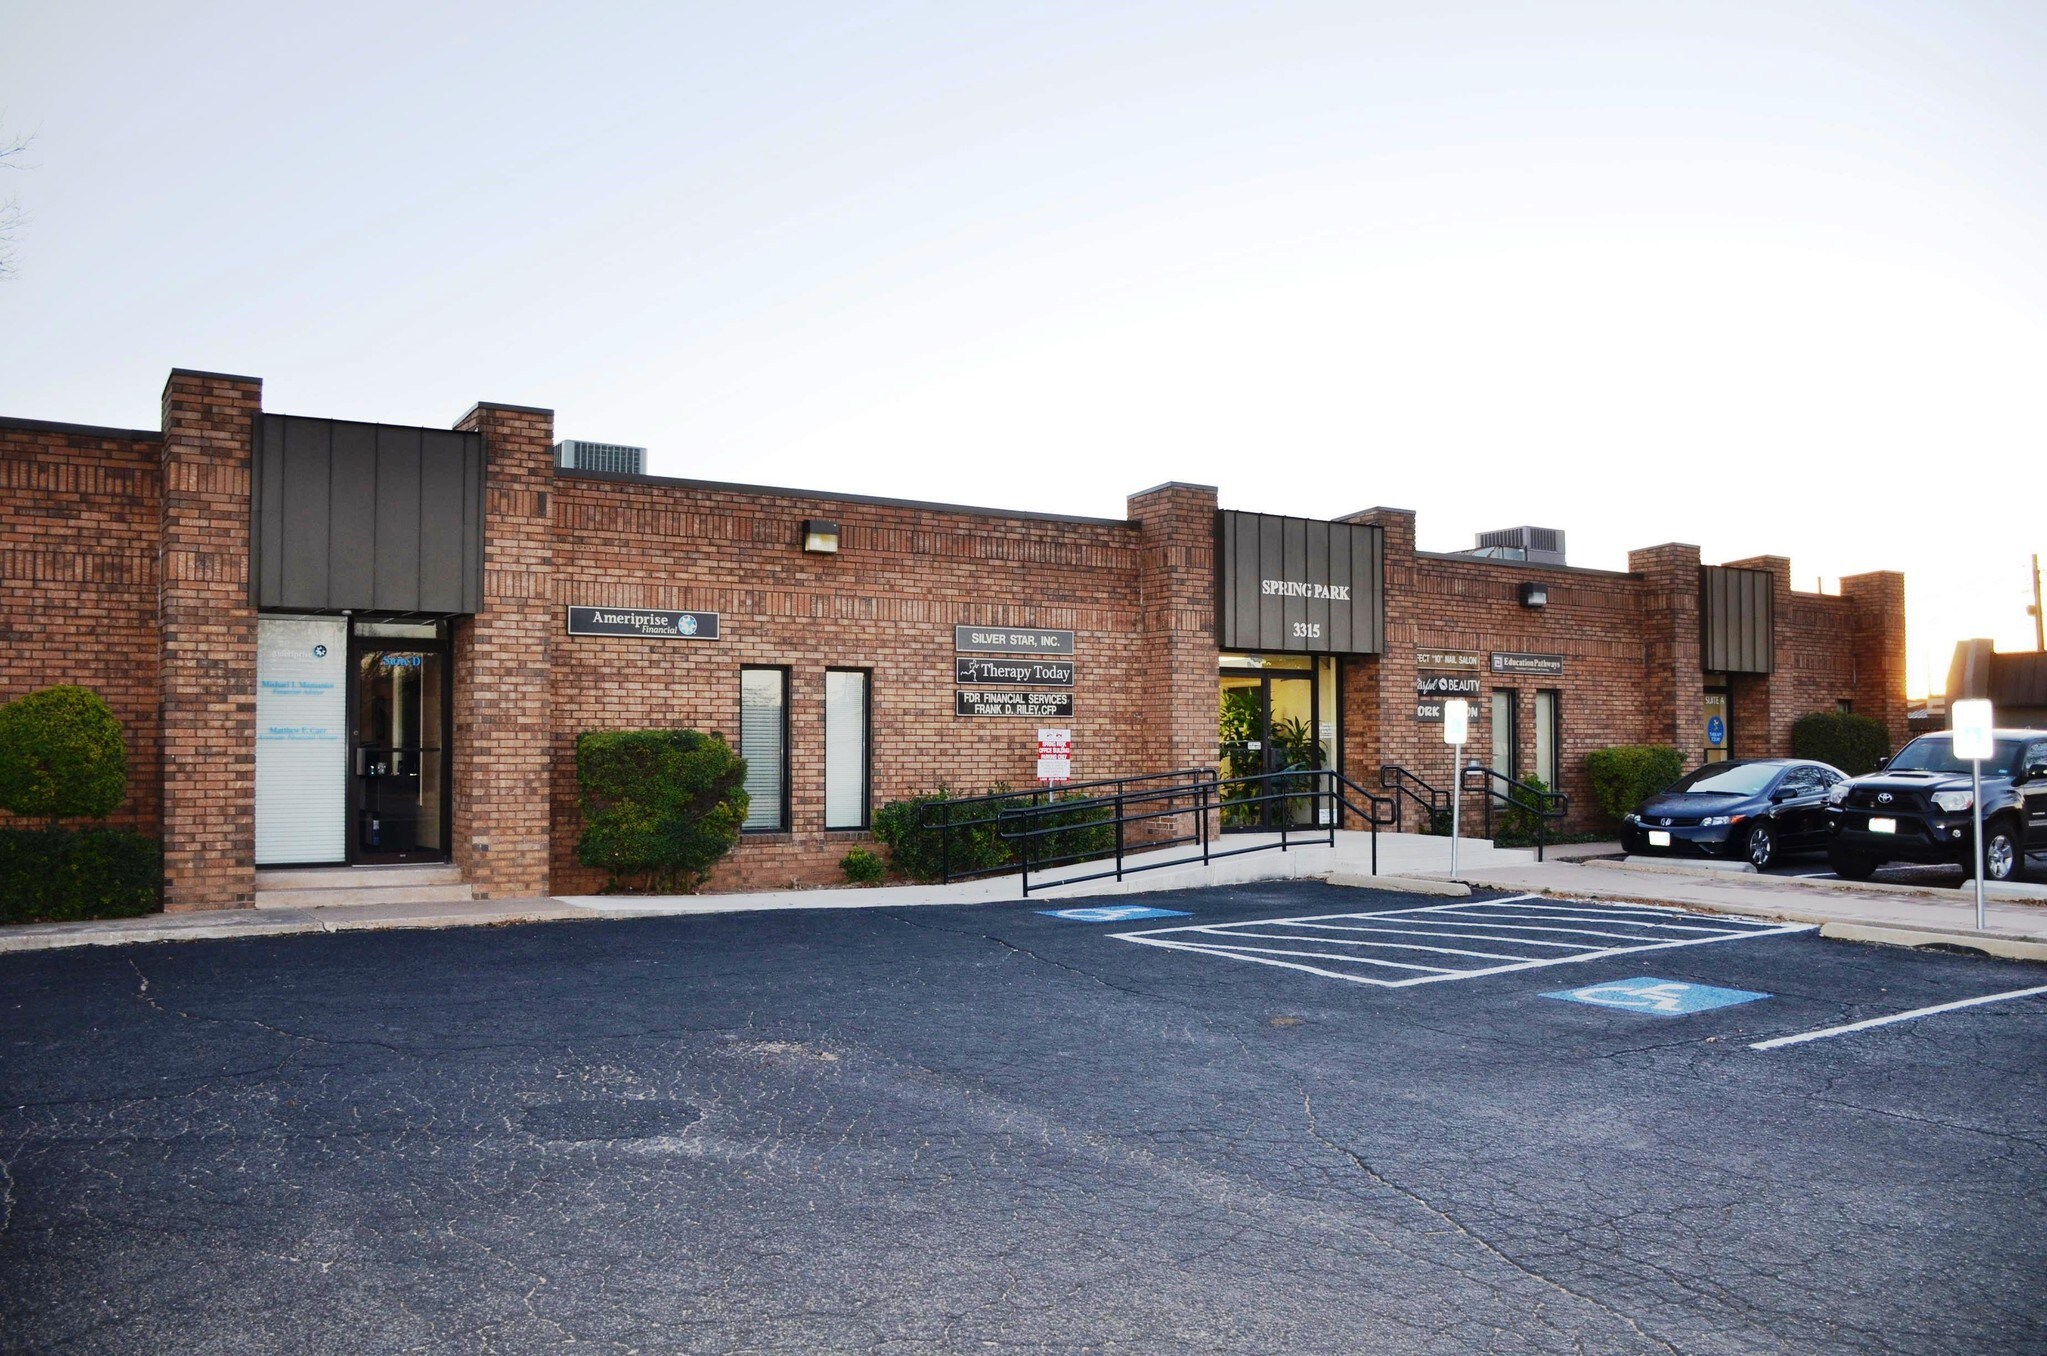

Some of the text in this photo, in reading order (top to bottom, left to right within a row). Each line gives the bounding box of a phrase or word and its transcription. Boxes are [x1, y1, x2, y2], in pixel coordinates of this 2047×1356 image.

[1262, 579, 1350, 601] SPRING PARK
[592, 611, 669, 628] Ameriprise
[641, 625, 678, 635] Financial
[1293, 622, 1320, 638] 3315
[971, 633, 1061, 648] SILVER STAR, INC.
[1458, 655, 1477, 665] SALON
[980, 662, 1071, 682] Therapy Today
[1448, 679, 1480, 692] BEAUTY
[963, 693, 1068, 705] FDR FINANCIAL SERVICES
[974, 704, 1003, 714] FRANK
[1005, 704, 1014, 714] D.
